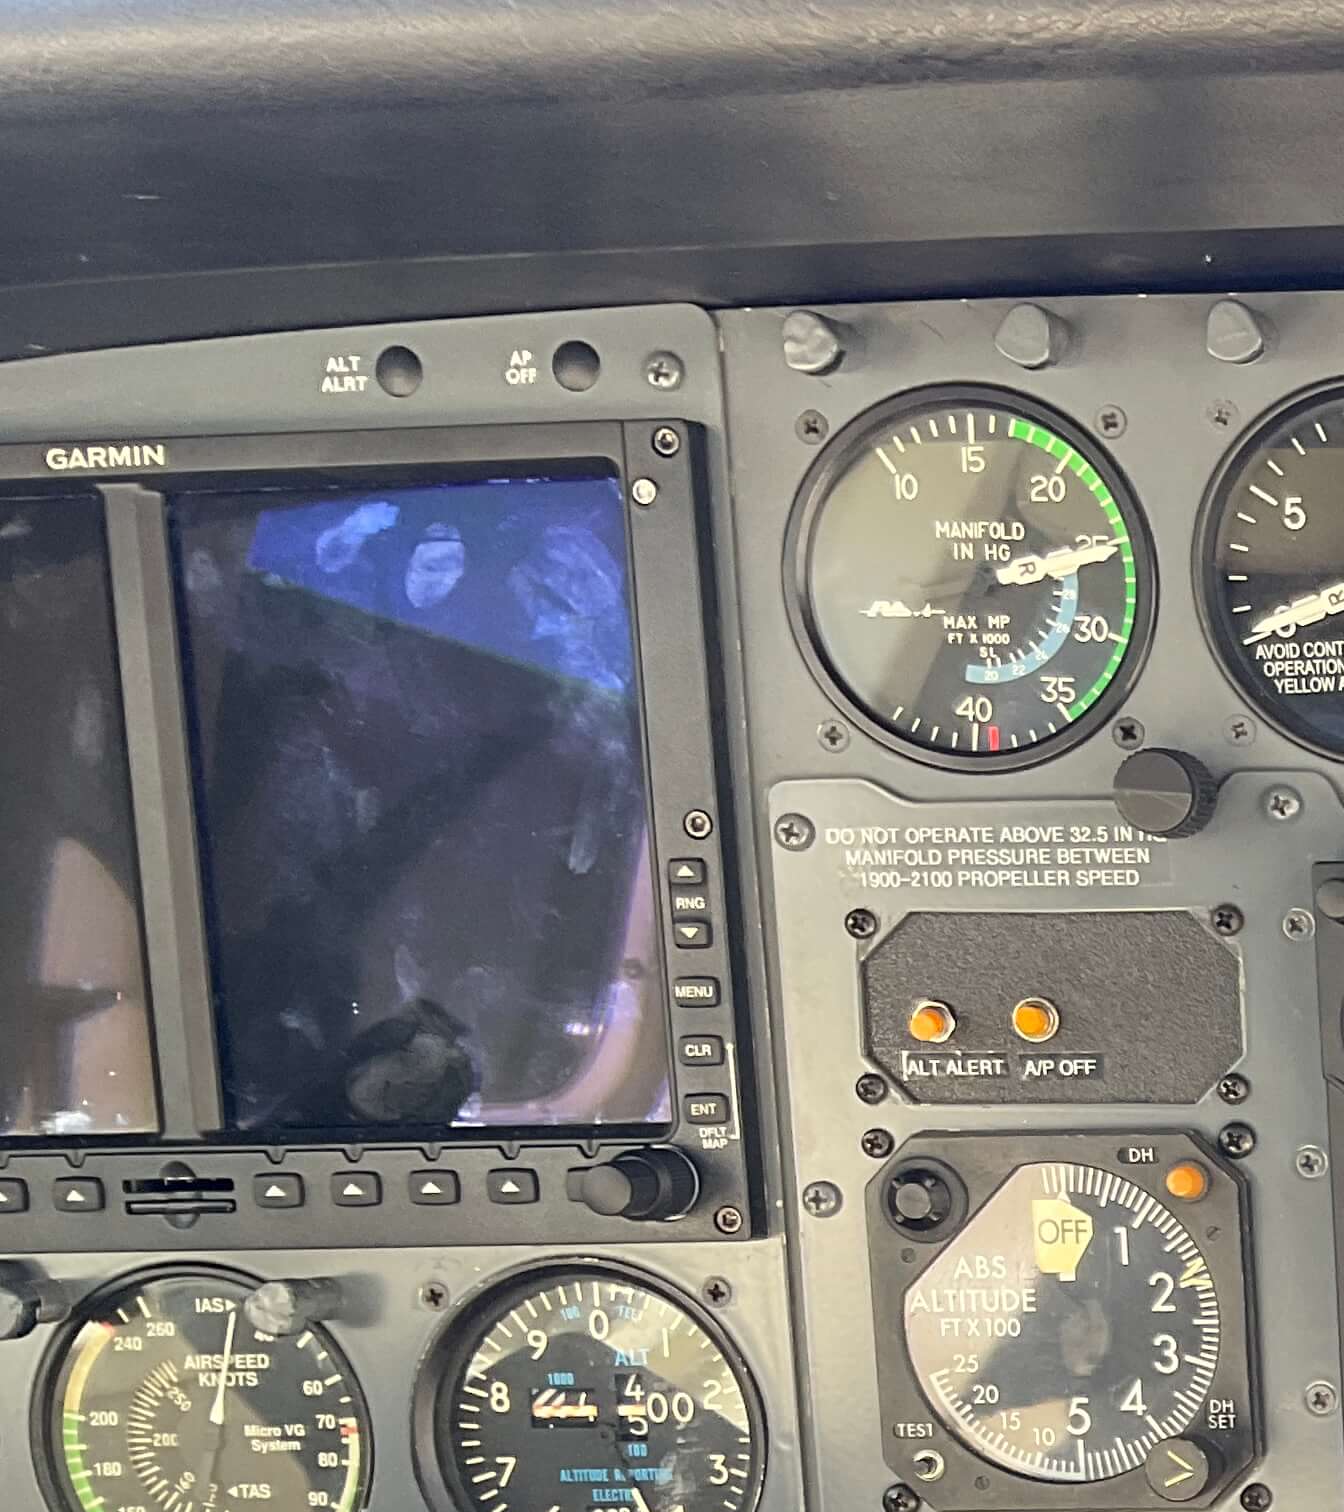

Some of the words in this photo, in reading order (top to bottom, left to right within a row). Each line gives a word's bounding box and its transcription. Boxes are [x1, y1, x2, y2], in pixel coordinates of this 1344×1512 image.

[326, 356, 360, 374] ALT
[322, 375, 368, 394] ALRT
[505, 368, 537, 386] OFF
[46, 445, 165, 470] GARMIN
[962, 447, 985, 472] 15
[935, 521, 1024, 539] MANIFOLD
[954, 544, 973, 560] IN
[985, 545, 1010, 560] HG
[1256, 644, 1300, 659] AVOID
[1274, 677, 1335, 694] YELLOW
[826, 828, 854, 845] DO
[861, 828, 898, 844] NOT
[905, 827, 995, 844] OPERATE
[1000, 827, 1063, 843] ABOVE
[1070, 826, 1108, 843] 32.5
[1113, 826, 1134, 842] IN
[846, 849, 941, 866] MANIFOLD
[948, 849, 1050, 865] PRESSURE
[1057, 848, 1149, 864] BETWEEN
[860, 871, 952, 888] 1900-2100
[958, 870, 1069, 887] PROPELLER
[1076, 869, 1140, 886] SPEED
[674, 986, 713, 999] MENU
[908, 1061, 940, 1076] ALT
[946, 1060, 1003, 1075] ALERT
[1024, 1060, 1056, 1076] A/P
[1059, 1059, 1096, 1075] OFF
[1038, 1220, 1087, 1243] OFF
[953, 1257, 1006, 1277] ABS
[910, 1290, 1036, 1313] ALTITUDE
[238, 1483, 271, 1499] TAS
